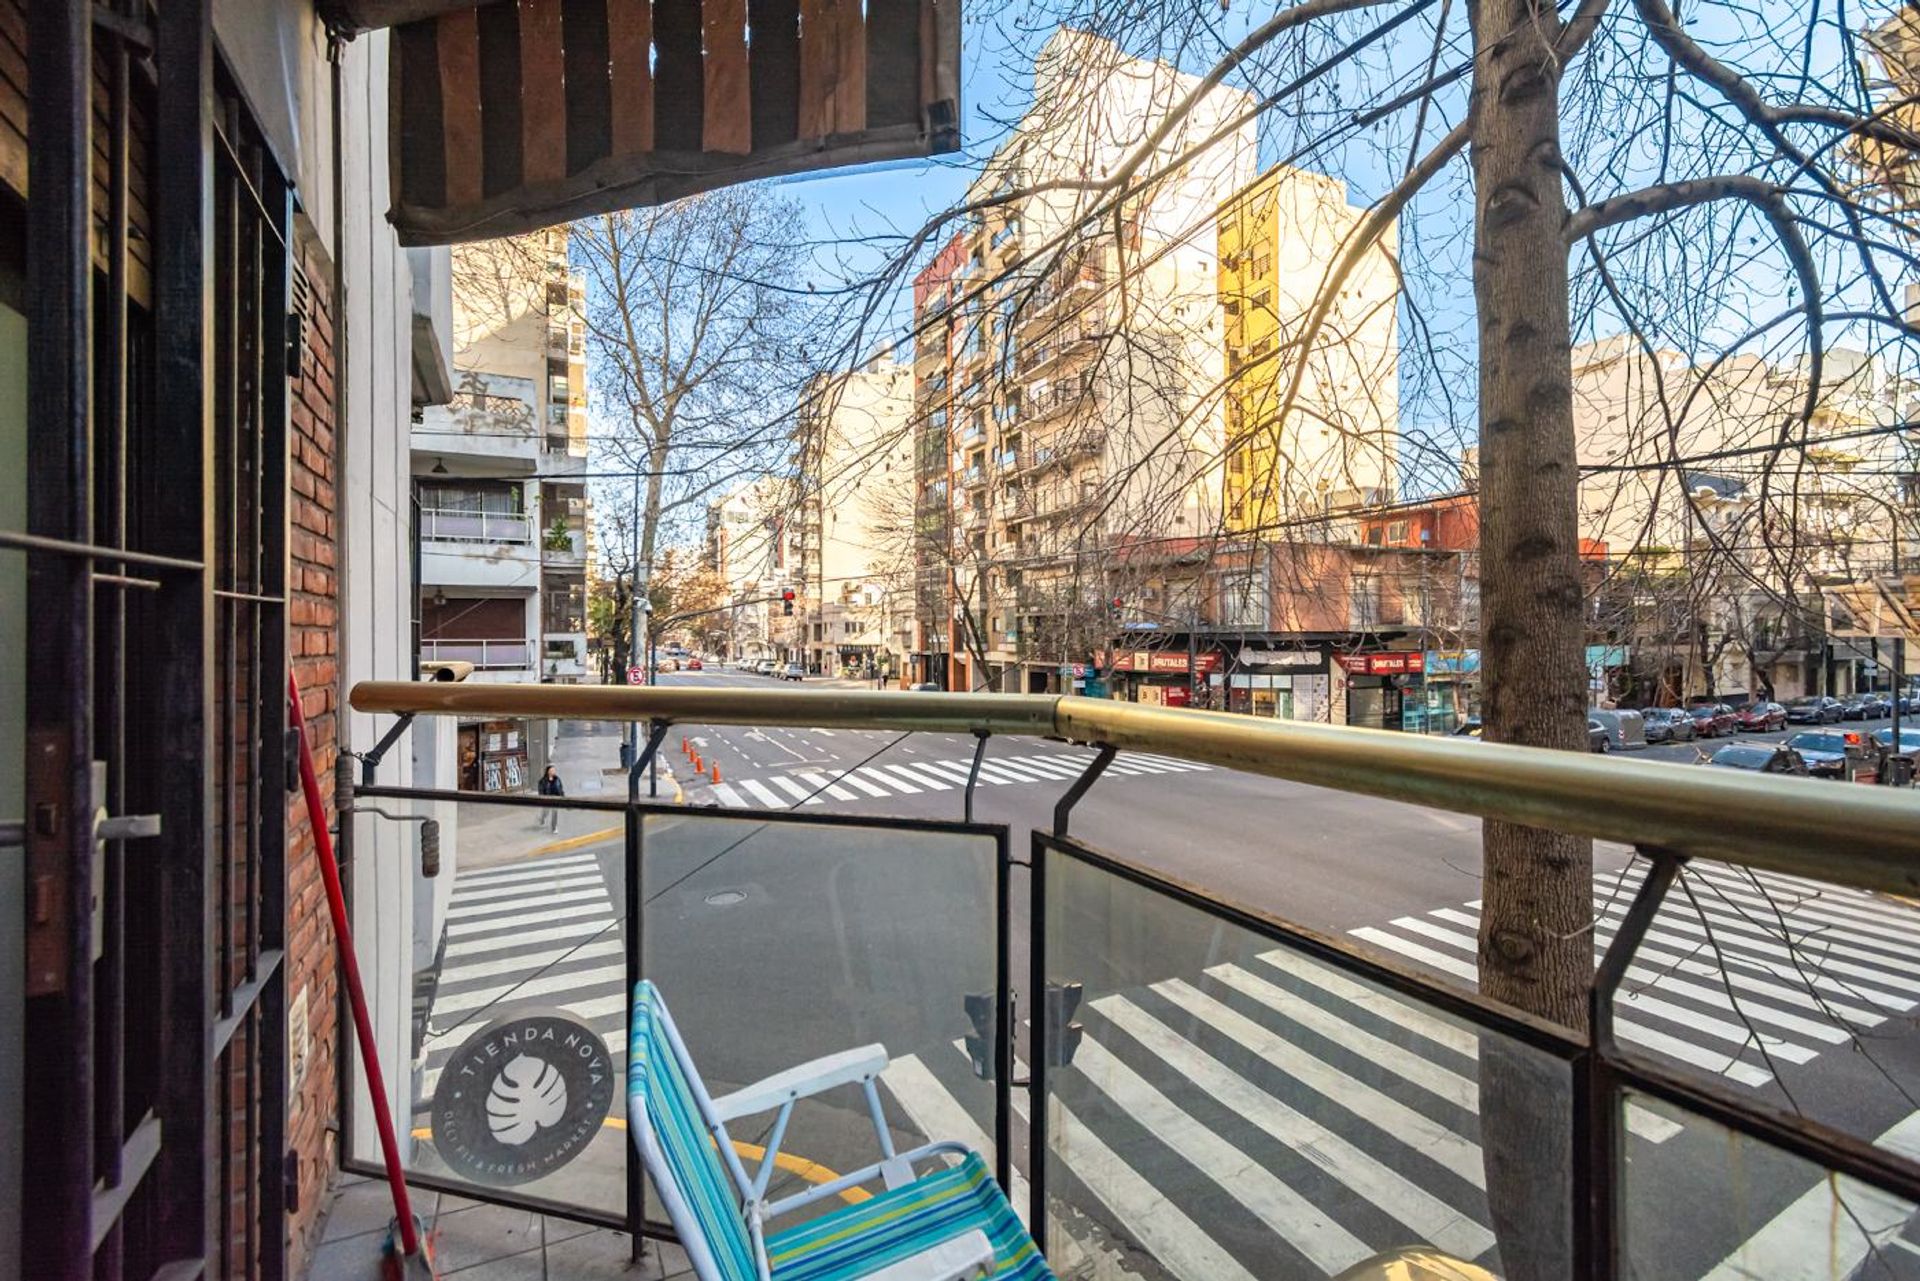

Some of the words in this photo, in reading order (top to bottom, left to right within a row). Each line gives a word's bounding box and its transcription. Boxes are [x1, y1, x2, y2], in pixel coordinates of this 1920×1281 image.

[1153, 658, 1188, 668] BRUTALES
[460, 1027, 554, 1078] TIENDA
[564, 1033, 603, 1086] NOVA
[544, 1119, 592, 1165] MARKET
